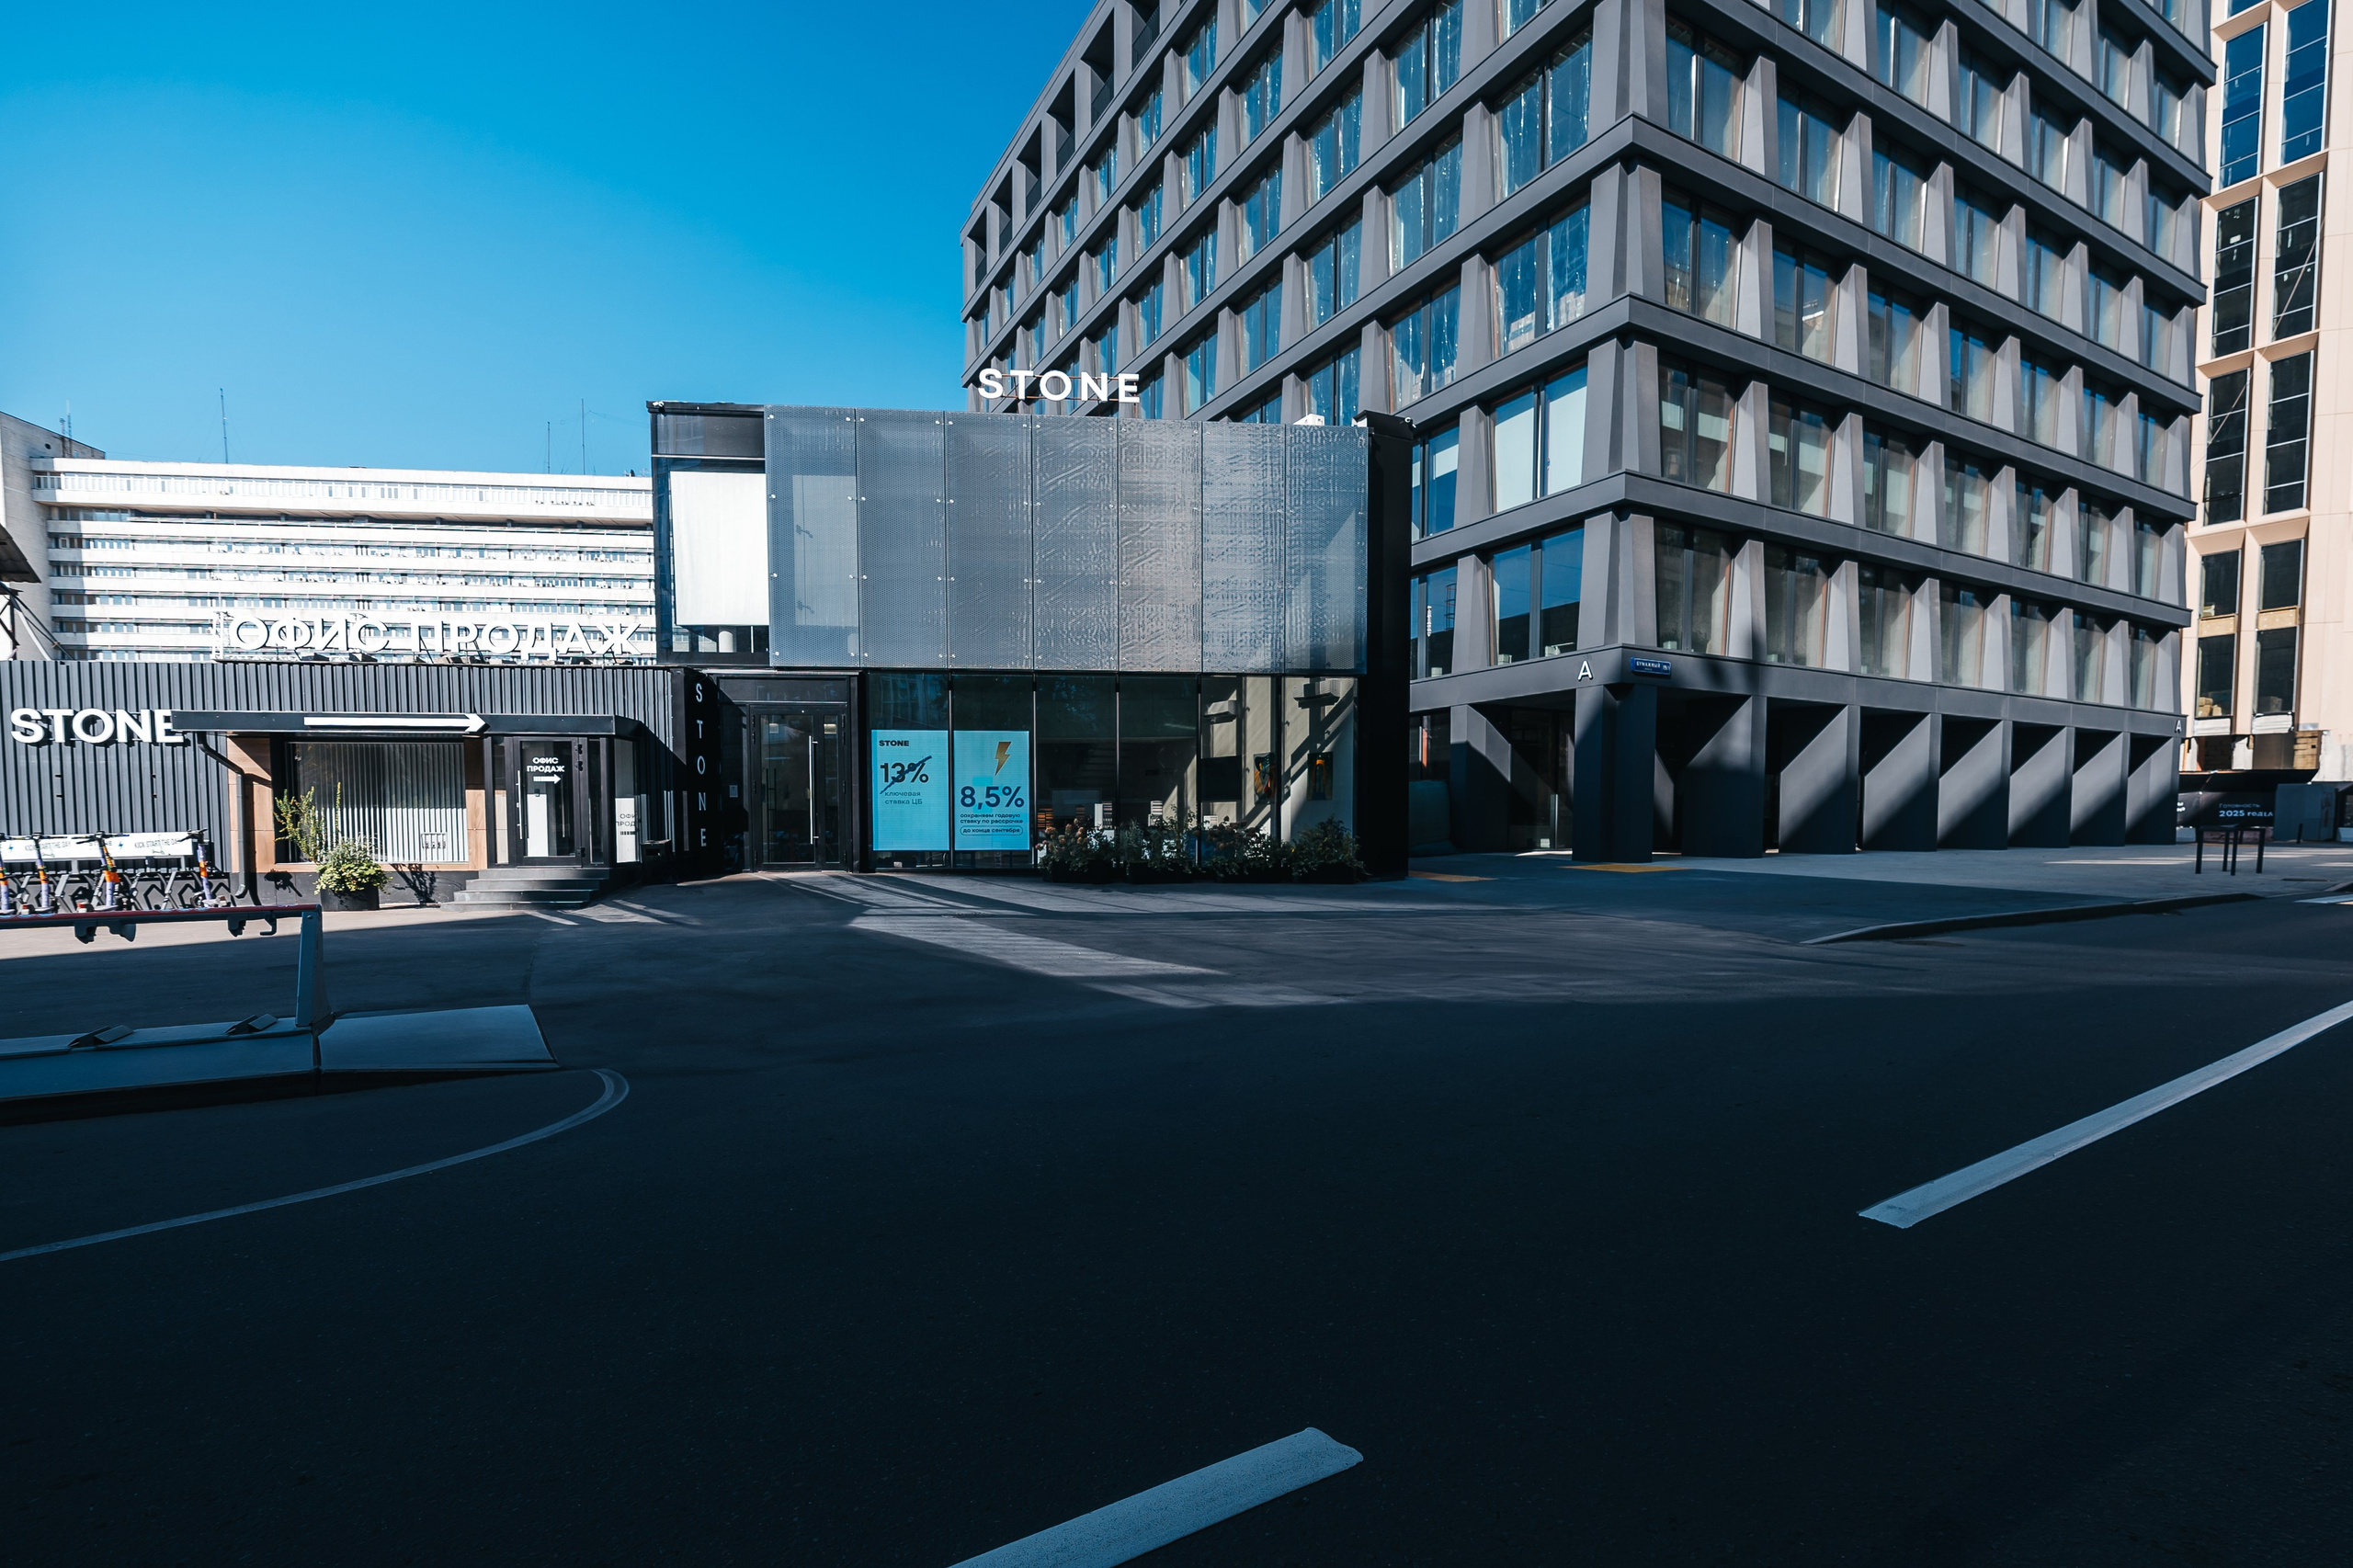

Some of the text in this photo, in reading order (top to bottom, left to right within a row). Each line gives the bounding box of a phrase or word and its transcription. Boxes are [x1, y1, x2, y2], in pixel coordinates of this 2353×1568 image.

[978, 369, 1140, 403] STONE
[229, 617, 642, 660] ОФИС ПРОДАЖ
[10, 708, 184, 744] STONE
[527, 765, 565, 773] ПРОДАЖ
[532, 756, 559, 765] ОФИС
[696, 683, 708, 846] STONE
[880, 762, 929, 783] 13%
[961, 786, 1024, 810] 8,5%
